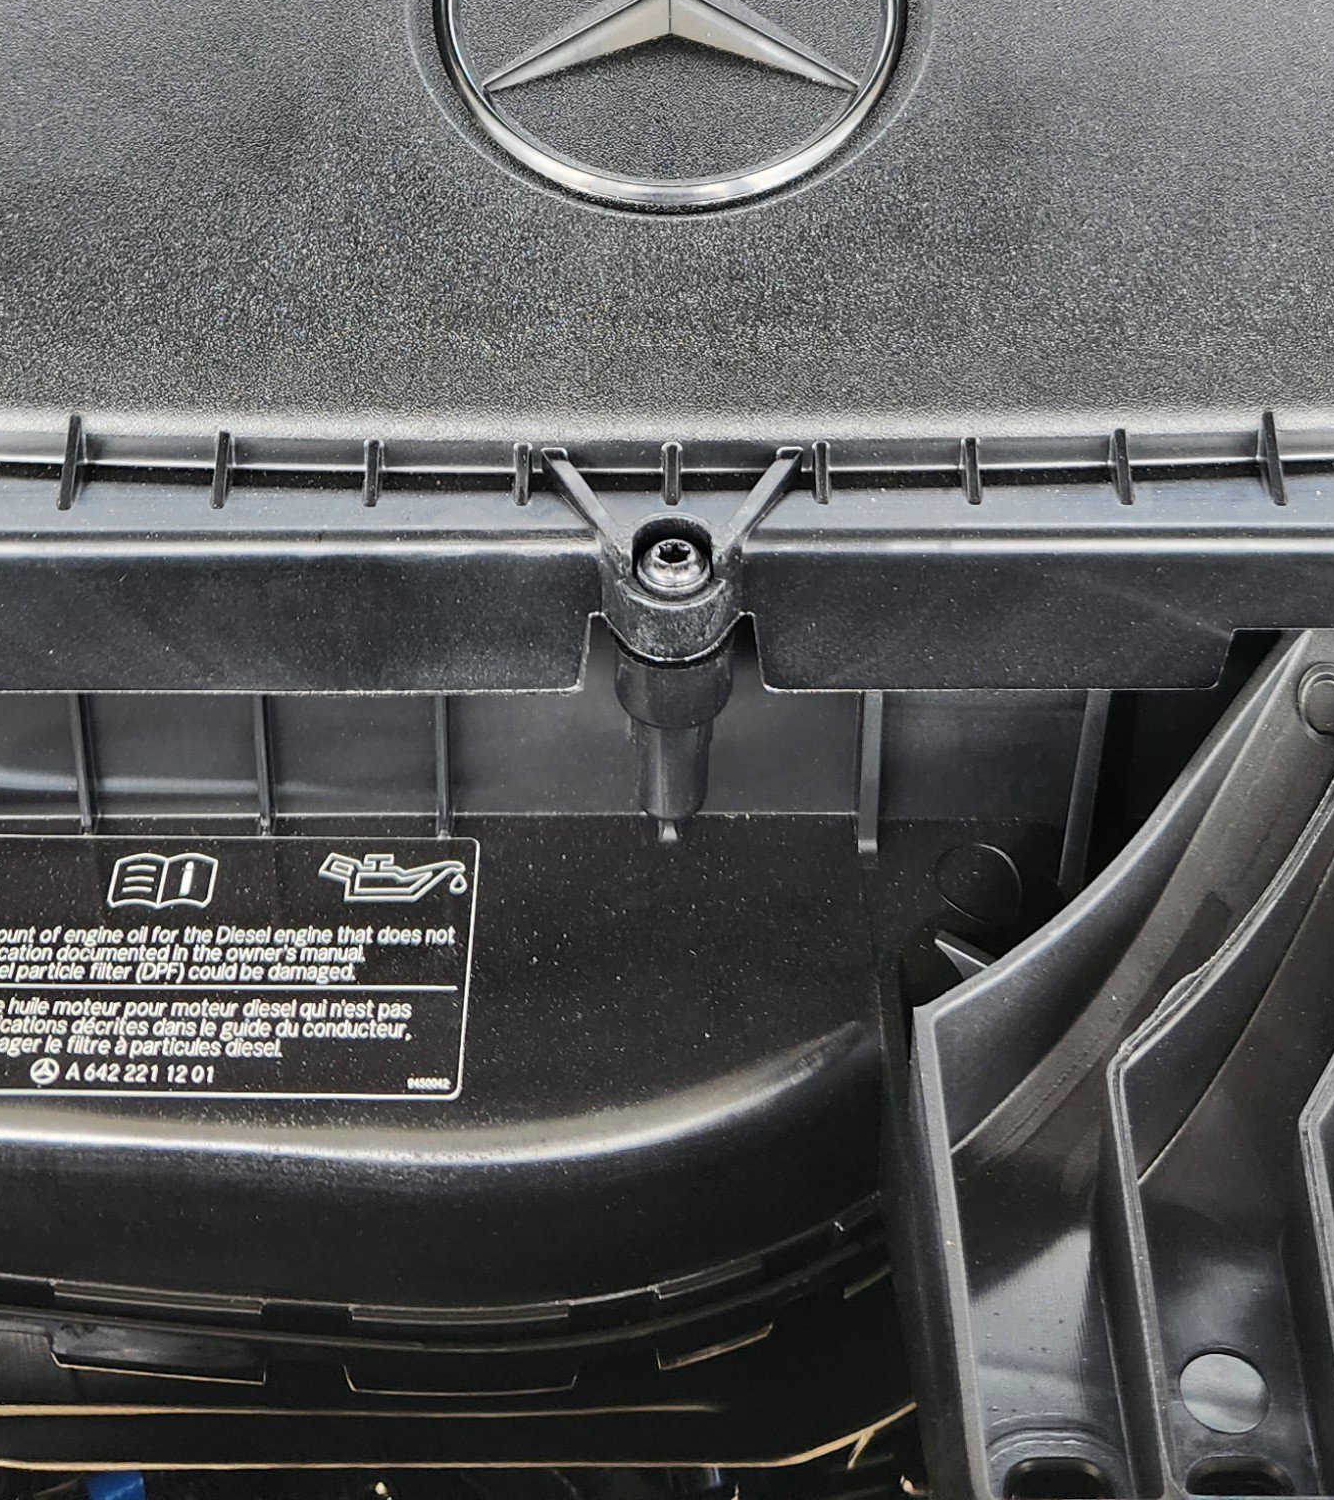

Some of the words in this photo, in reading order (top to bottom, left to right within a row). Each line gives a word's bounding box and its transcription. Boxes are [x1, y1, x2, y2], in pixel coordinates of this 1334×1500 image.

[39, 925, 62, 944] of
[64, 925, 124, 947] engine
[127, 925, 148, 944] oil
[151, 925, 179, 944] for
[183, 925, 213, 945] the
[217, 925, 271, 945] Diesel
[274, 925, 333, 947] engine
[337, 925, 373, 945] that
[377, 925, 422, 946] does
[424, 925, 456, 946] not
[56, 944, 170, 962] documented
[172, 943, 188, 962] in
[192, 944, 222, 962] the
[225, 944, 297, 963] owner's
[299, 944, 366, 963] manual.
[15, 962, 85, 982] particle
[89, 962, 132, 980] filter
[135, 962, 185, 984] (DPF)
[187, 963, 238, 981] could
[238, 963, 264, 981] be
[267, 963, 356, 984] damaged.
[7, 996, 50, 1015] huile
[52, 998, 121, 1016] moteur
[123, 1001, 168, 1019] pour
[170, 998, 239, 1017] moteur
[242, 998, 297, 1018] diesel
[299, 998, 328, 1021] qui
[329, 998, 376, 1018] n'est
[377, 1001, 412, 1022] pas
[71, 1015, 149, 1036] décrites
[152, 1017, 198, 1036] dans
[200, 1017, 217, 1037] le
[220, 1017, 272, 1041] guide
[275, 1018, 299, 1038] du
[302, 1018, 413, 1041] conducteur,
[44, 1034, 63, 1054] le
[66, 1035, 112, 1055] filtre
[114, 1035, 128, 1056] à
[129, 1037, 222, 1059] particules
[225, 1037, 283, 1058] diesel.
[65, 1062, 81, 1082] A
[84, 1062, 121, 1083] 642
[123, 1063, 159, 1083] 221
[167, 1064, 188, 1084] 12
[191, 1064, 215, 1084] 01
